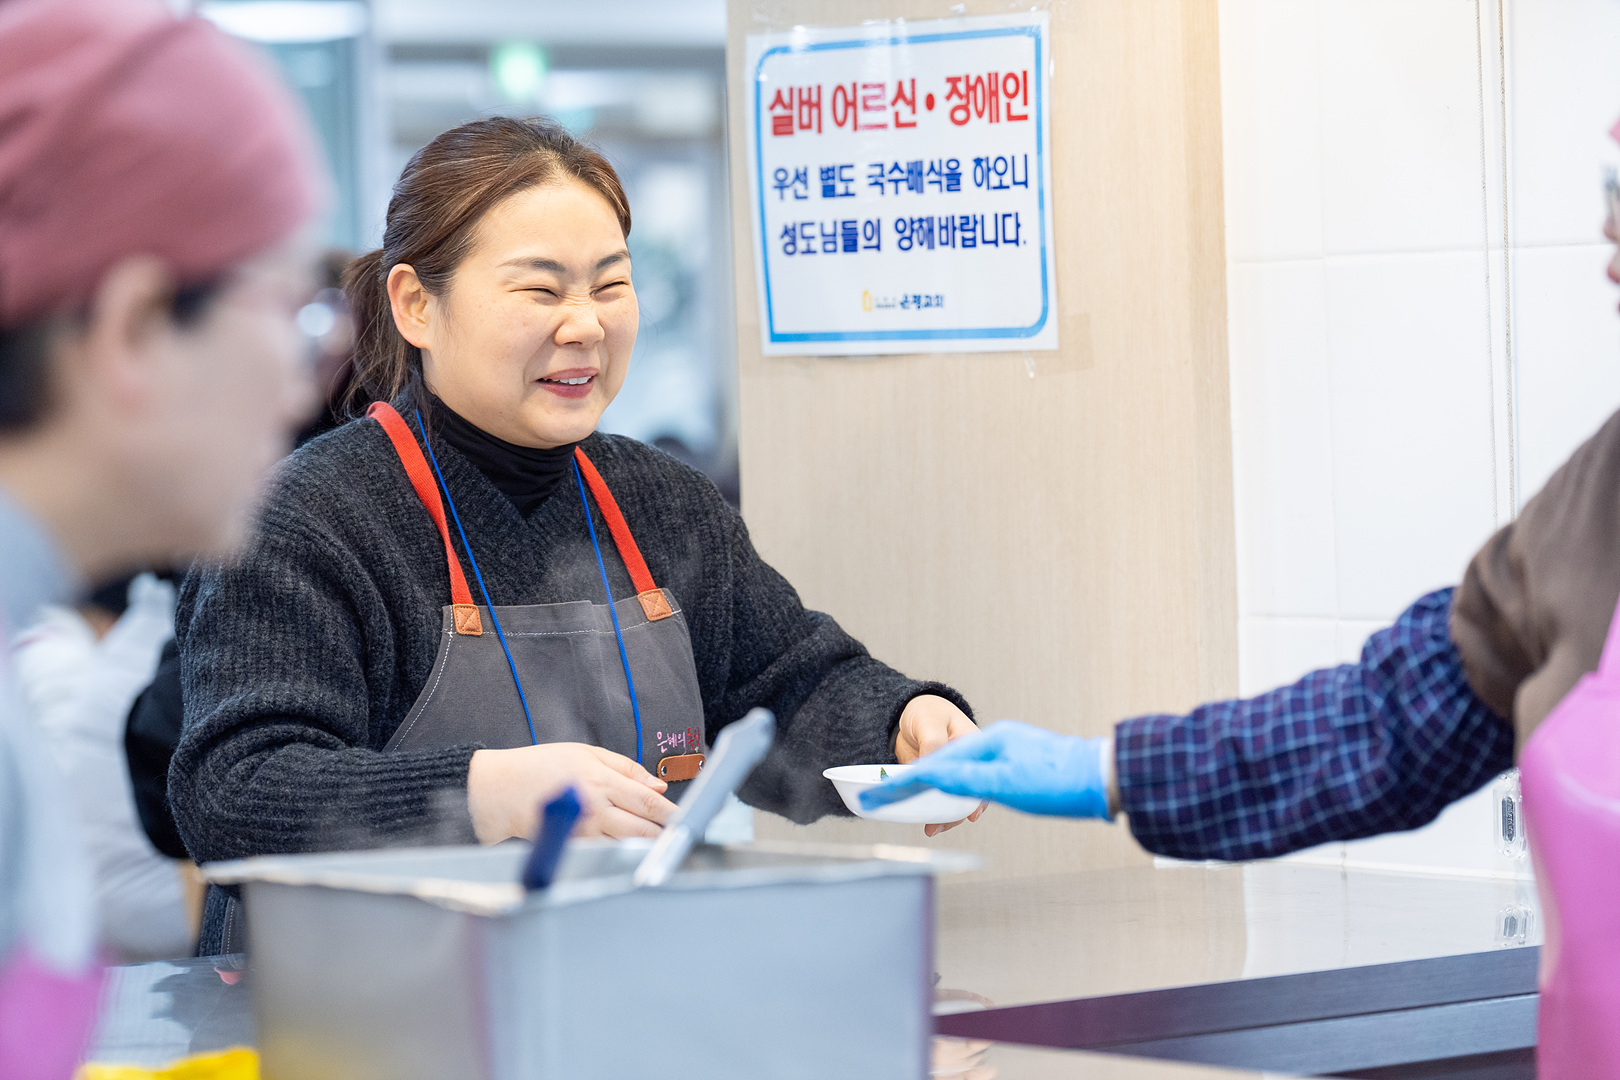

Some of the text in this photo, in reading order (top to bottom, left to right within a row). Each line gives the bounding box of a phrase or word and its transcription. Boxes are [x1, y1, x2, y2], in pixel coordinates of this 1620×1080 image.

[769, 84, 823, 137] 실버
[945, 70, 1029, 127] 장애인
[772, 154, 1029, 200] 우선 별도 국수배식을 하오니
[780, 218, 881, 257] 성도님들의
